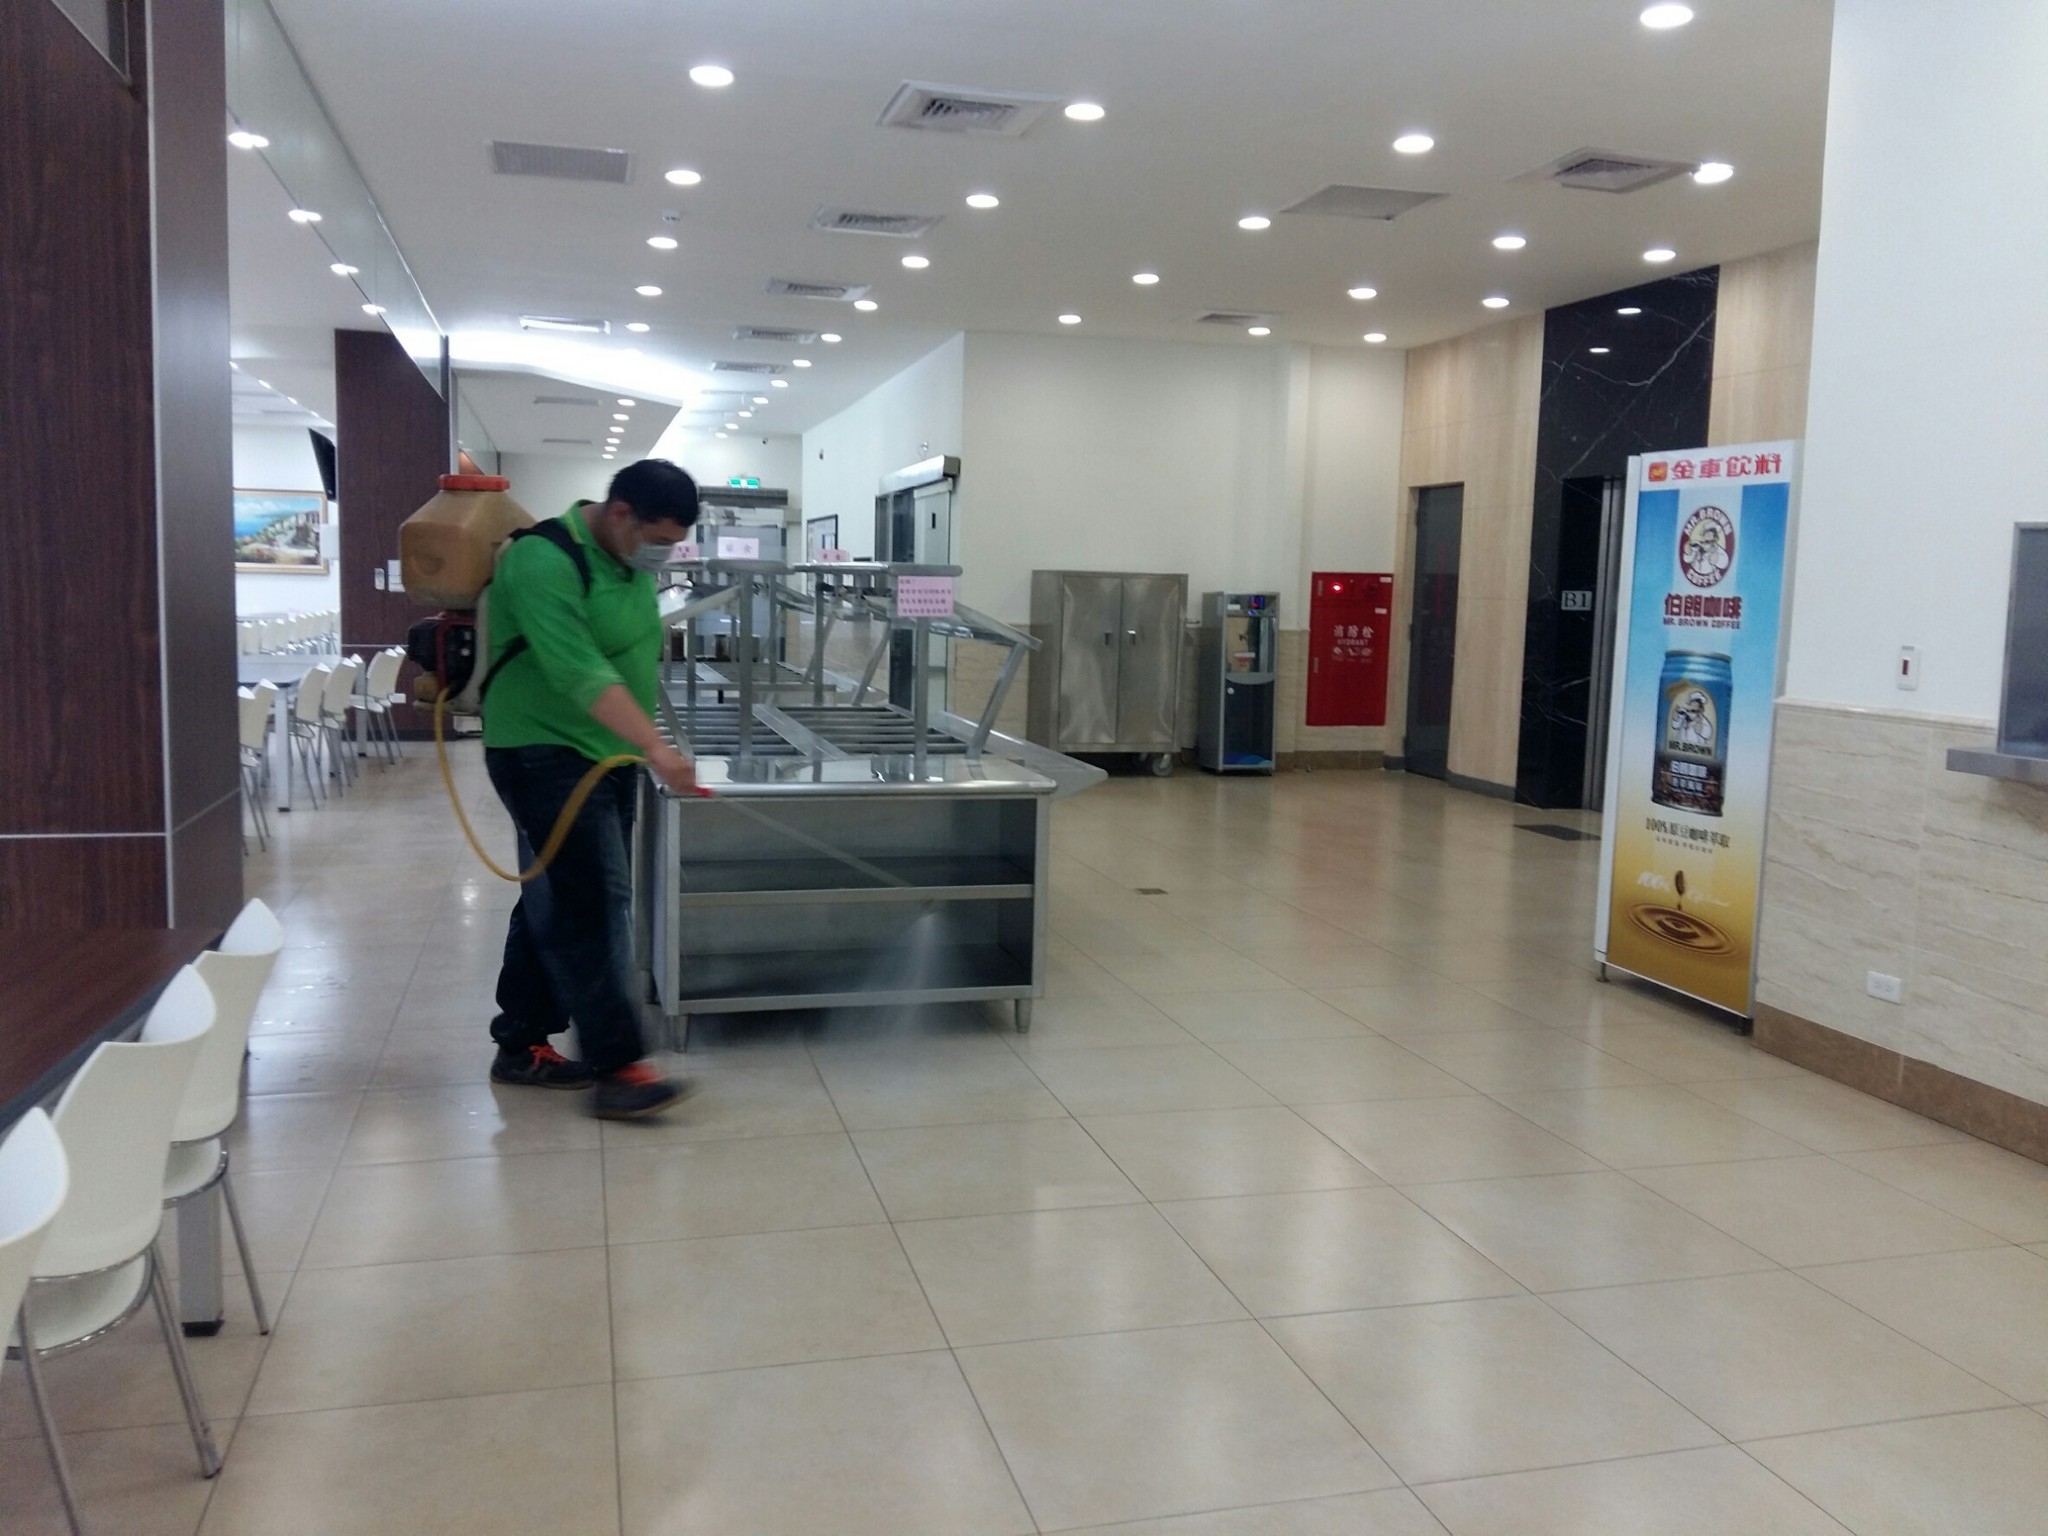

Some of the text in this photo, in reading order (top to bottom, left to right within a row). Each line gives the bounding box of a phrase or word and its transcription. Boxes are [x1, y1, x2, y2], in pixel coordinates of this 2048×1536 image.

[1671, 453, 1782, 481] 金車飲料
[1699, 508, 1732, 535] BROWN
[1665, 593, 1742, 618] 伯朗咖啡
[1678, 618, 1709, 627] BROWN
[1711, 619, 1741, 630] COFFEE
